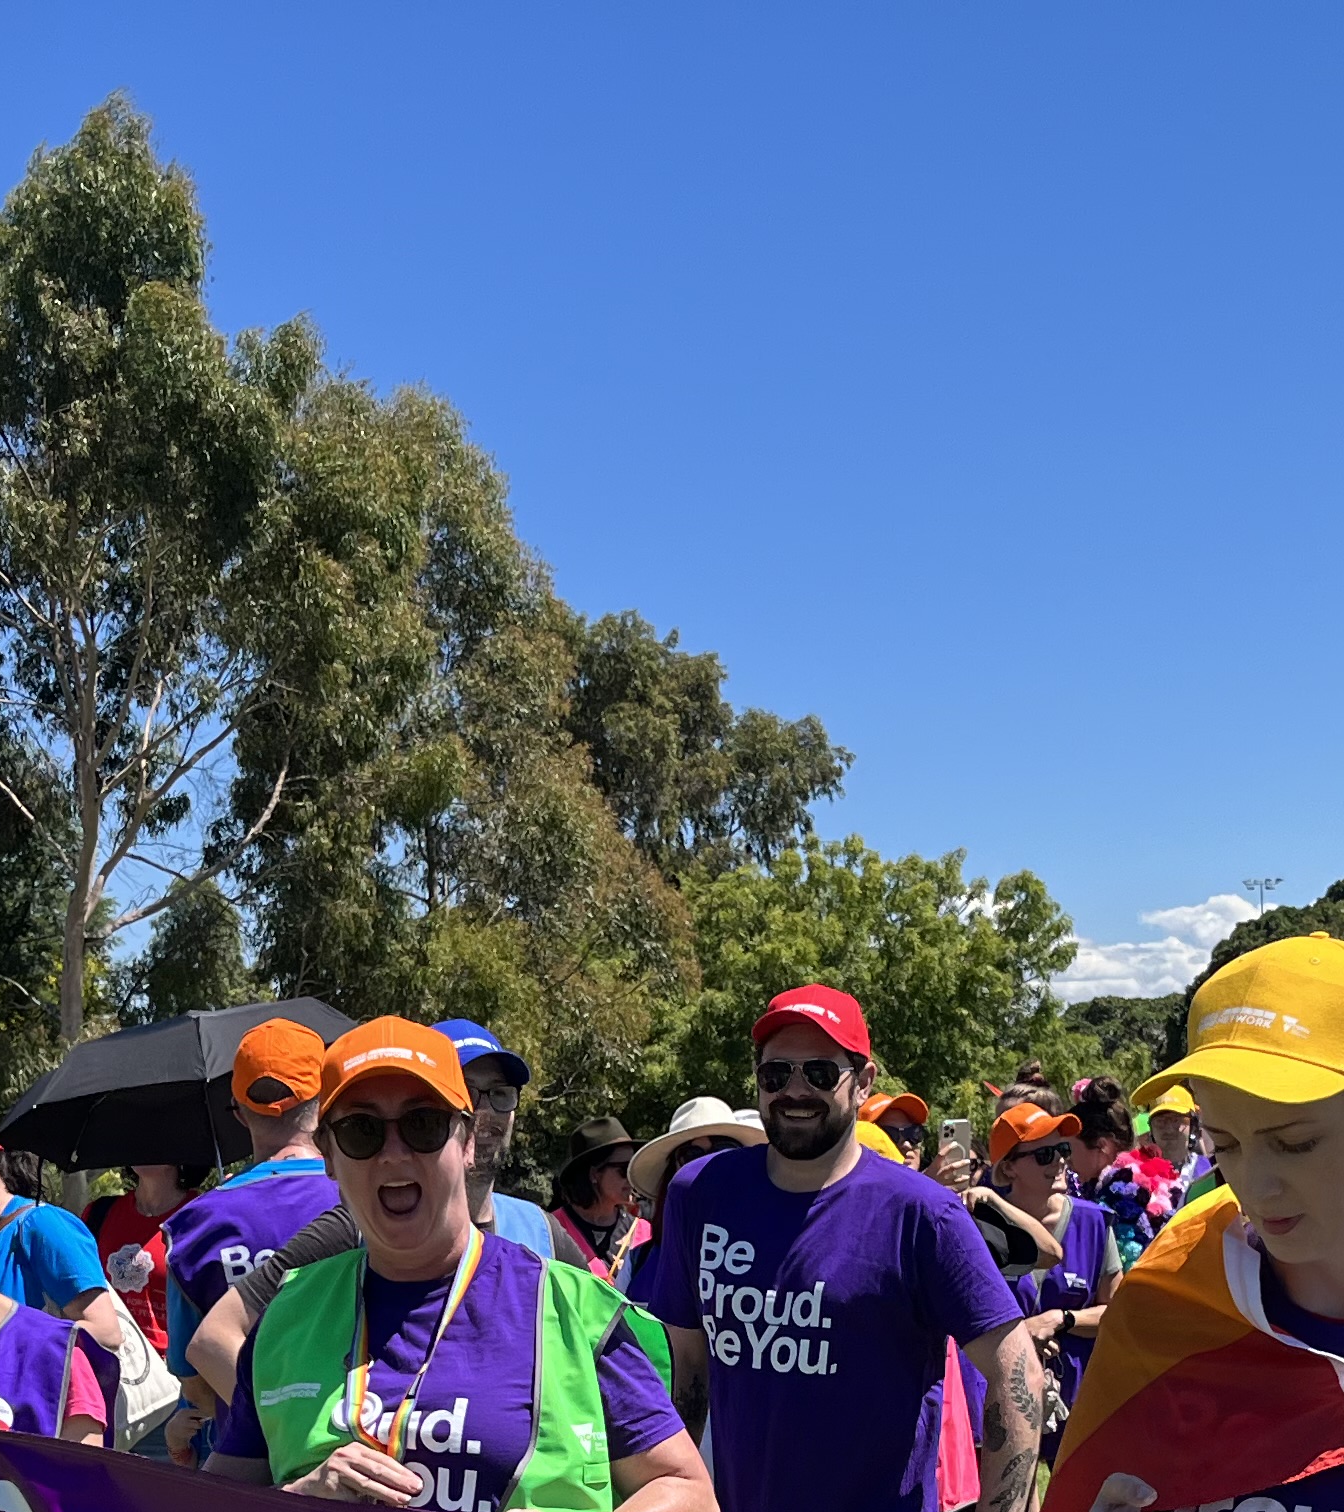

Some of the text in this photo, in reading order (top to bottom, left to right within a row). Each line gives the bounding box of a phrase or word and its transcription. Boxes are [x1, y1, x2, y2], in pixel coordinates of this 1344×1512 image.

[700, 1223, 755, 1275] Be
[699, 1270, 832, 1329] Proud.
[744, 1322, 838, 1376] You.
